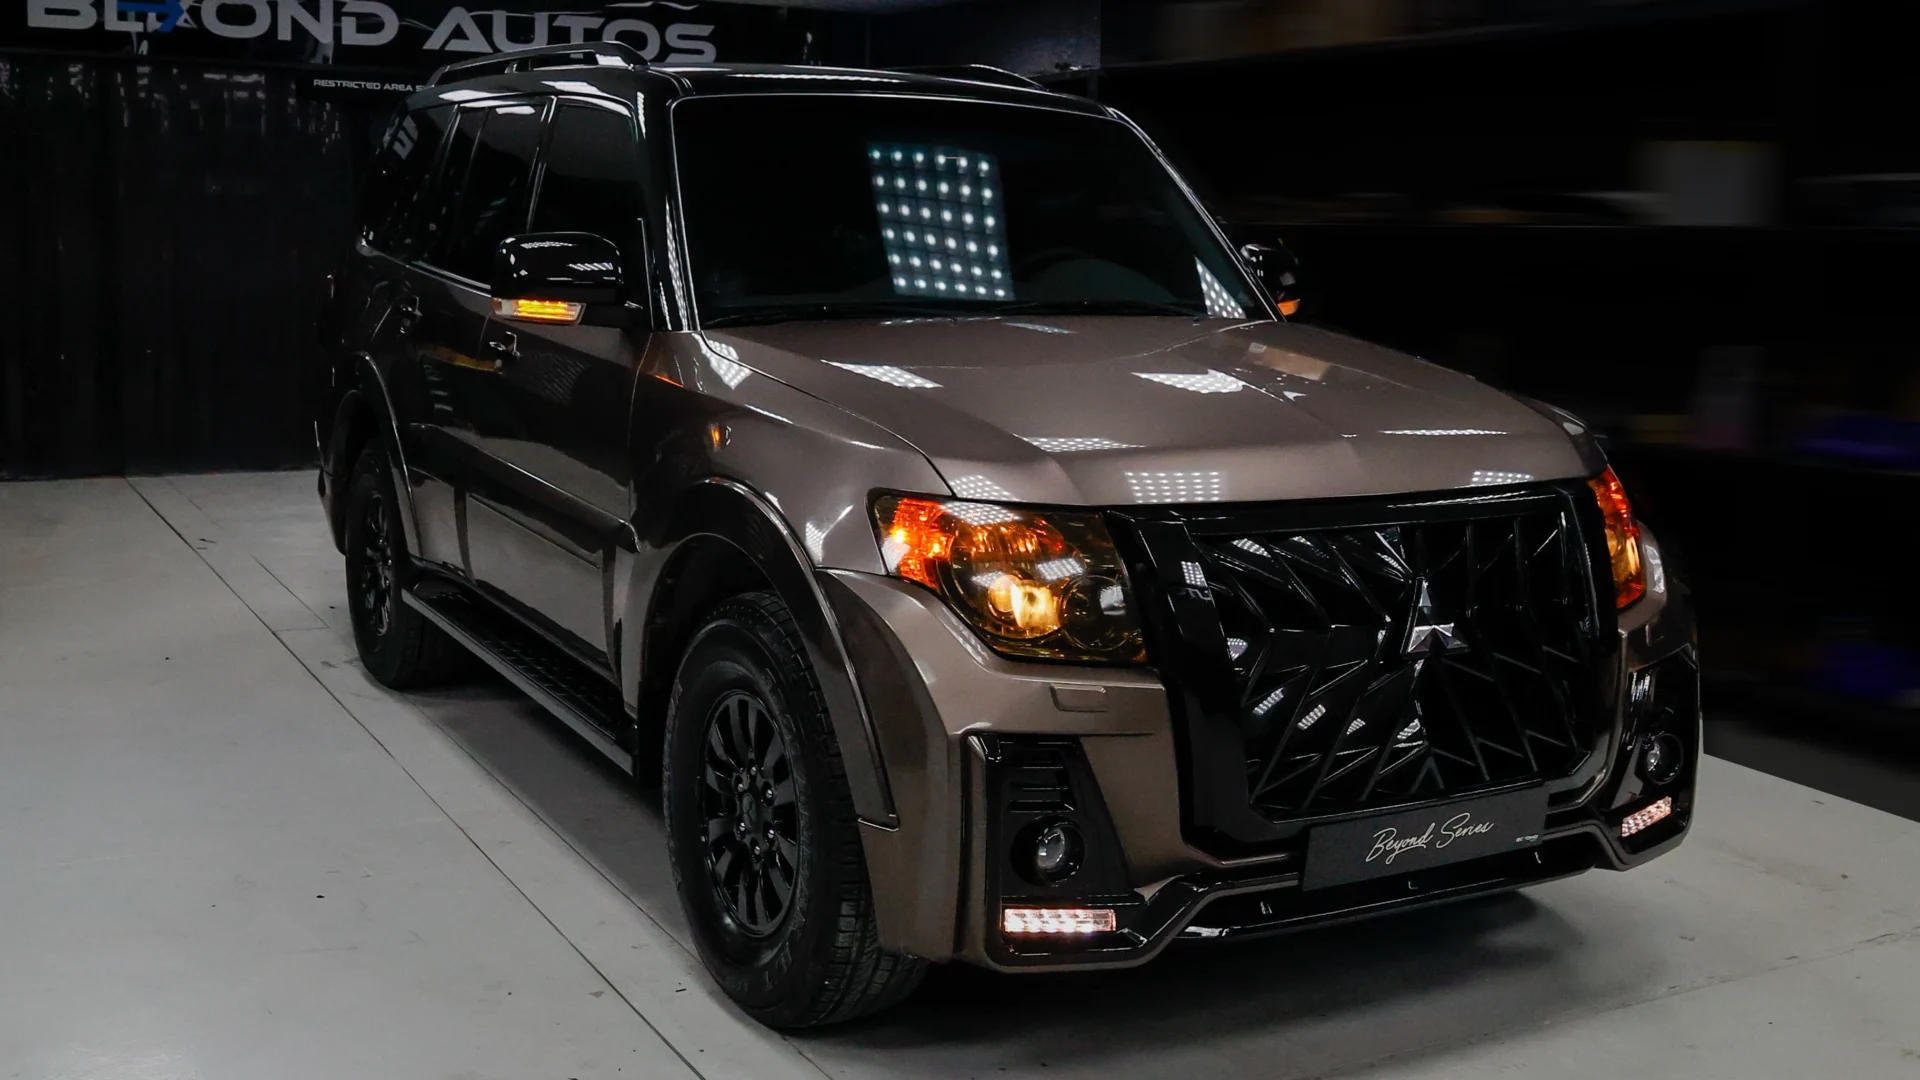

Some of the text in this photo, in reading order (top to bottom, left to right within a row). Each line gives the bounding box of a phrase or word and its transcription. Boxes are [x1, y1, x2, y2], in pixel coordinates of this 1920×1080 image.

[422, 6, 717, 64] AUTOS
[313, 79, 381, 90] RESTRICTED
[383, 83, 413, 92] AREA
[1365, 812, 1495, 865] Beyond Series
